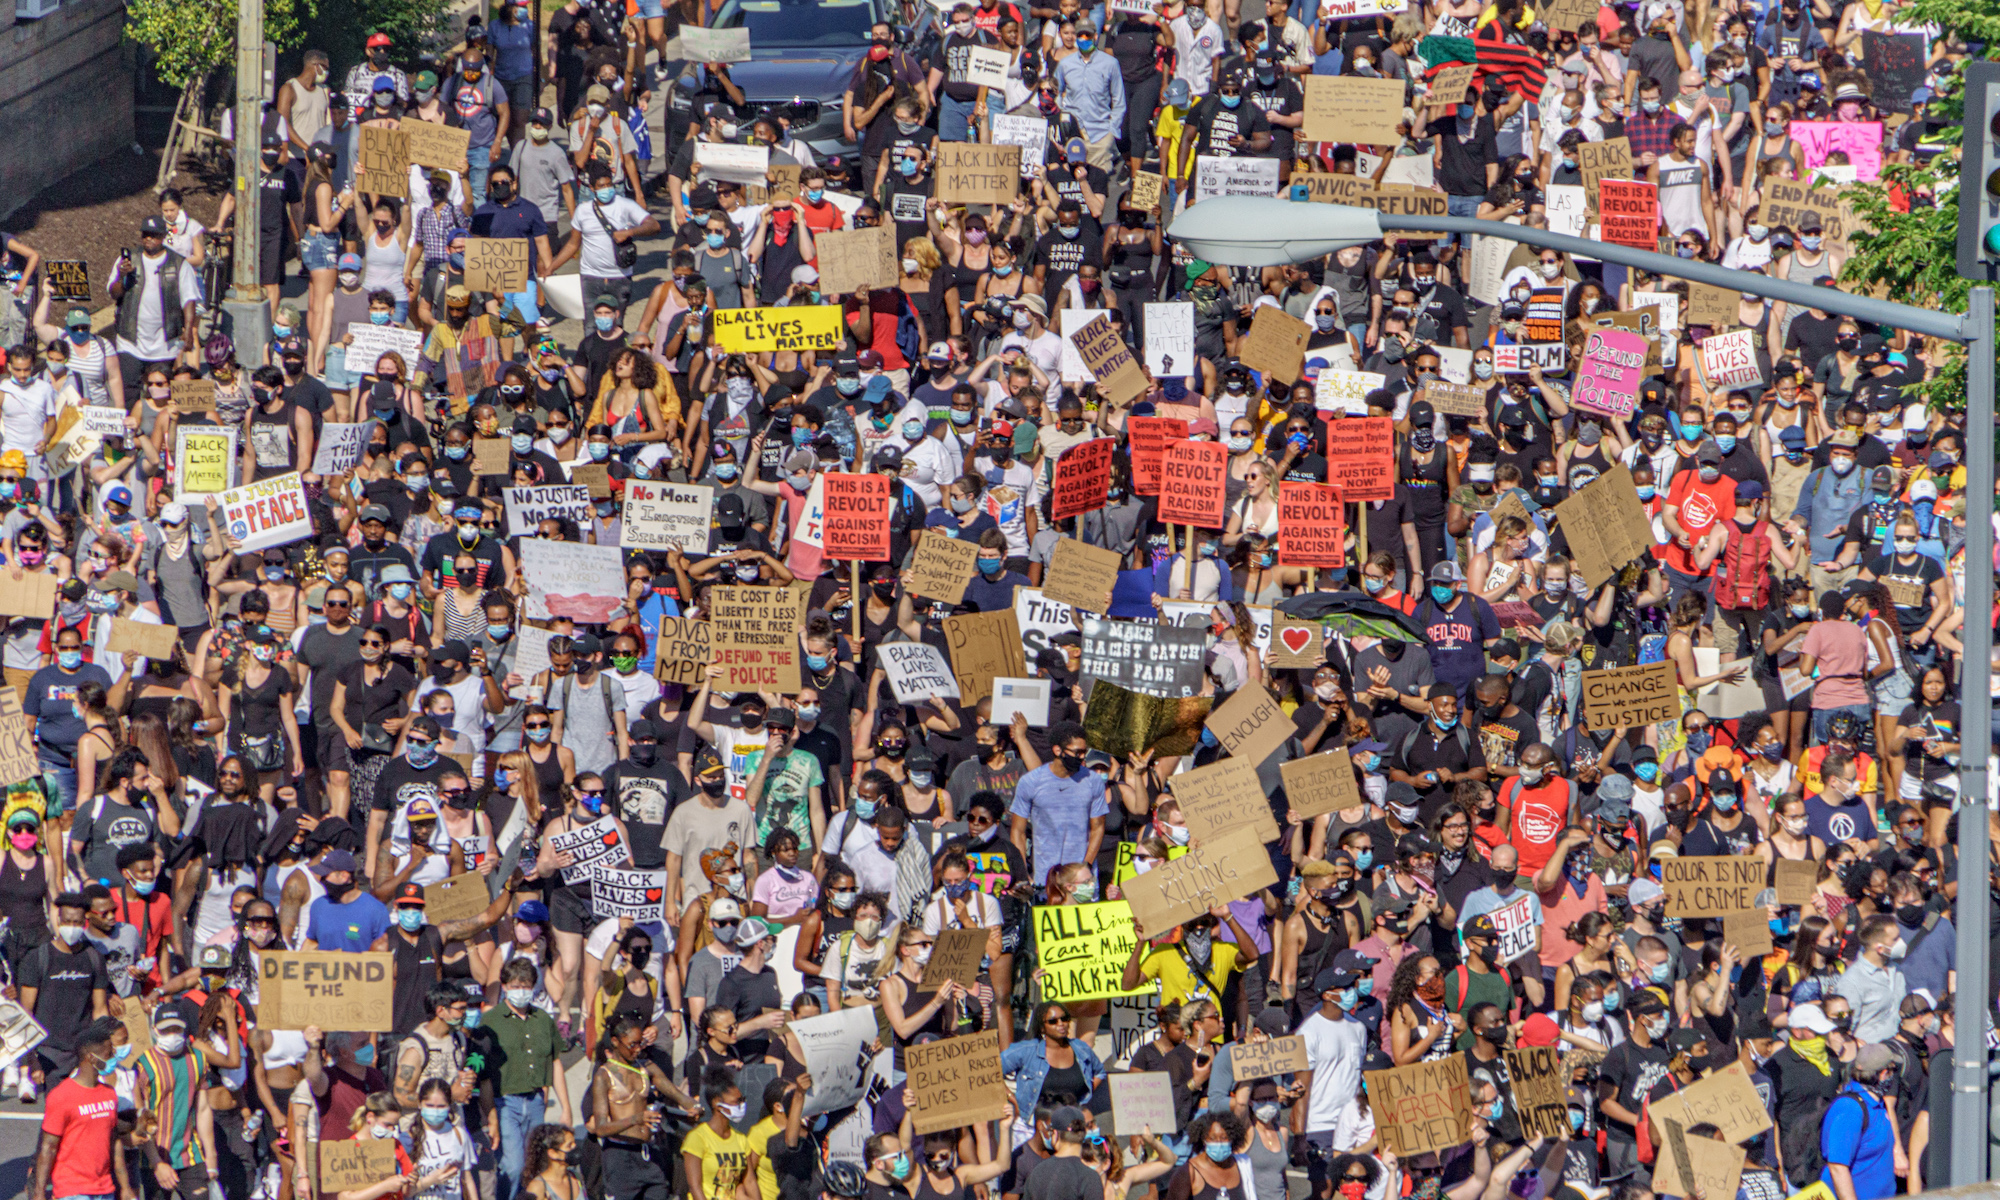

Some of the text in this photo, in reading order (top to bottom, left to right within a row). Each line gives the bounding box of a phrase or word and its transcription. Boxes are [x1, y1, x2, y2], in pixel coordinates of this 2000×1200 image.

[1329, 1, 1356, 14] PAIN
[365, 129, 408, 153] BLACK
[364, 152, 408, 172] LIVES
[938, 150, 1020, 168] BLACK LIVES
[1202, 161, 1258, 173] WE WILL
[1583, 147, 1628, 169] BLACK
[362, 172, 407, 196] MATTER
[949, 174, 1008, 190] MATTER
[1202, 176, 1260, 186] RID AMERICA
[1667, 169, 1694, 184] NIKE
[1204, 188, 1218, 196] THE
[1604, 185, 1653, 199] THIS IS A
[1771, 184, 1802, 201] END
[1360, 196, 1446, 215] DEFUND
[1603, 199, 1653, 213] REVOLT
[1603, 218, 1653, 229] AGAINST
[1607, 229, 1650, 240] RACISM
[470, 257, 527, 270] SHOOT
[486, 270, 518, 290] ME
[716, 311, 764, 327] BLACK
[1147, 305, 1189, 320] BLACK
[745, 320, 803, 340] LIVES
[1072, 317, 1112, 350] BLACK
[1150, 320, 1189, 336] LIVES
[776, 326, 839, 350] MATTER!
[1146, 336, 1192, 352] MATTER
[1705, 332, 1749, 353] BLACK
[1083, 334, 1118, 363] LIVES
[1094, 350, 1132, 380] MATTER
[1519, 347, 1565, 369] BLM
[1708, 349, 1749, 371] LIVES
[1580, 375, 1634, 414] POLICE
[340, 425, 365, 442] SAY
[1336, 421, 1385, 433] George Floyd
[185, 440, 227, 453] BLACK
[1332, 433, 1389, 444] Breonna Taylor
[190, 454, 221, 464] LIVES
[1168, 447, 1223, 464] THIS IS A
[1332, 446, 1389, 457] Ahmaud Arbery
[186, 469, 223, 484] MATTER
[1059, 457, 1107, 478] REVOLT
[1166, 462, 1222, 482] REVOLT
[1336, 467, 1386, 478] JUSTICE
[244, 474, 300, 500] JUSTICE
[829, 480, 885, 493] THIS IS A
[1058, 474, 1106, 494] AGAINST
[1164, 481, 1221, 499] AGAINST
[1346, 478, 1377, 487] NOW!
[223, 489, 239, 504] NO
[512, 486, 588, 504] NO JUSTICE
[829, 496, 885, 511] REVOLT
[1060, 487, 1101, 505] RACISM
[1168, 496, 1216, 512] RACISM
[1283, 489, 1339, 503] THIS IS A
[228, 508, 243, 522] NO
[246, 490, 305, 533] PEACE
[641, 505, 705, 526] INACTION
[1283, 506, 1339, 521] REVOLT
[827, 518, 884, 531] AGAINST
[1282, 527, 1339, 539] AGAINST
[627, 526, 690, 546] SILENCE
[831, 532, 880, 545] RACISM
[925, 535, 956, 553] TIRED
[1286, 541, 1335, 552] RACISM
[741, 590, 790, 602] COST OF
[715, 605, 796, 621] LIBERTY IS LESS
[1028, 601, 1070, 624] This
[715, 619, 793, 633] THAN THE PRICE
[948, 620, 999, 648] Black
[1109, 622, 1153, 642] MAKE
[1426, 623, 1473, 642] RED SOX
[715, 632, 728, 644] OF
[671, 641, 711, 661] FROM
[715, 648, 792, 665] DEFUND THE
[889, 646, 933, 662] BLACK
[1083, 639, 1201, 660] RACIST CATCH
[659, 659, 707, 684] MPD
[730, 667, 778, 684] POLICE
[902, 659, 936, 677] LIVES
[1082, 660, 1174, 681] THIS FADE
[1608, 667, 1646, 678] We need
[898, 676, 949, 694] MATTER
[1589, 674, 1667, 698] CHANGE
[1224, 699, 1277, 750] ENOUGH
[1595, 705, 1672, 727] JUSTICE
[1309, 767, 1350, 786] JUSTICE
[1312, 782, 1351, 801] PEACE!
[551, 823, 605, 850] BLACK
[1161, 850, 1203, 881] STOP
[1665, 861, 1709, 883] COLOR
[1714, 861, 1728, 882] IS
[1734, 860, 1764, 883] NOT
[593, 867, 653, 886] BLACK
[1160, 857, 1238, 906] KILLING
[594, 884, 645, 904] LIVES
[1695, 887, 1750, 910] CRIME
[595, 901, 660, 919] MATTER
[1041, 906, 1094, 942] ALL
[950, 932, 975, 950] NOT
[938, 952, 970, 967] ONE
[264, 958, 384, 982] DEFUND
[929, 967, 966, 983] MORE
[305, 983, 343, 998] THE
[1043, 968, 1102, 1000] BLACK
[261, 1001, 385, 1025] ABUSERS
[1137, 1013, 1158, 1029] IS
[909, 1042, 962, 1069] DEFEND
[1233, 1038, 1298, 1062] DEFUND
[968, 1054, 999, 1073] RACIST
[1241, 1059, 1294, 1078] POLICE
[1507, 1048, 1558, 1084] BLACK
[916, 1067, 960, 1090] BLACK
[969, 1072, 1001, 1091] POLICE
[1377, 1060, 1465, 1099] HOW MANY
[78, 1099, 115, 1116] MILANO
[917, 1090, 959, 1112] LIVES
[1518, 1103, 1571, 1133] MATTER
[1380, 1108, 1472, 1153] FILMED?
